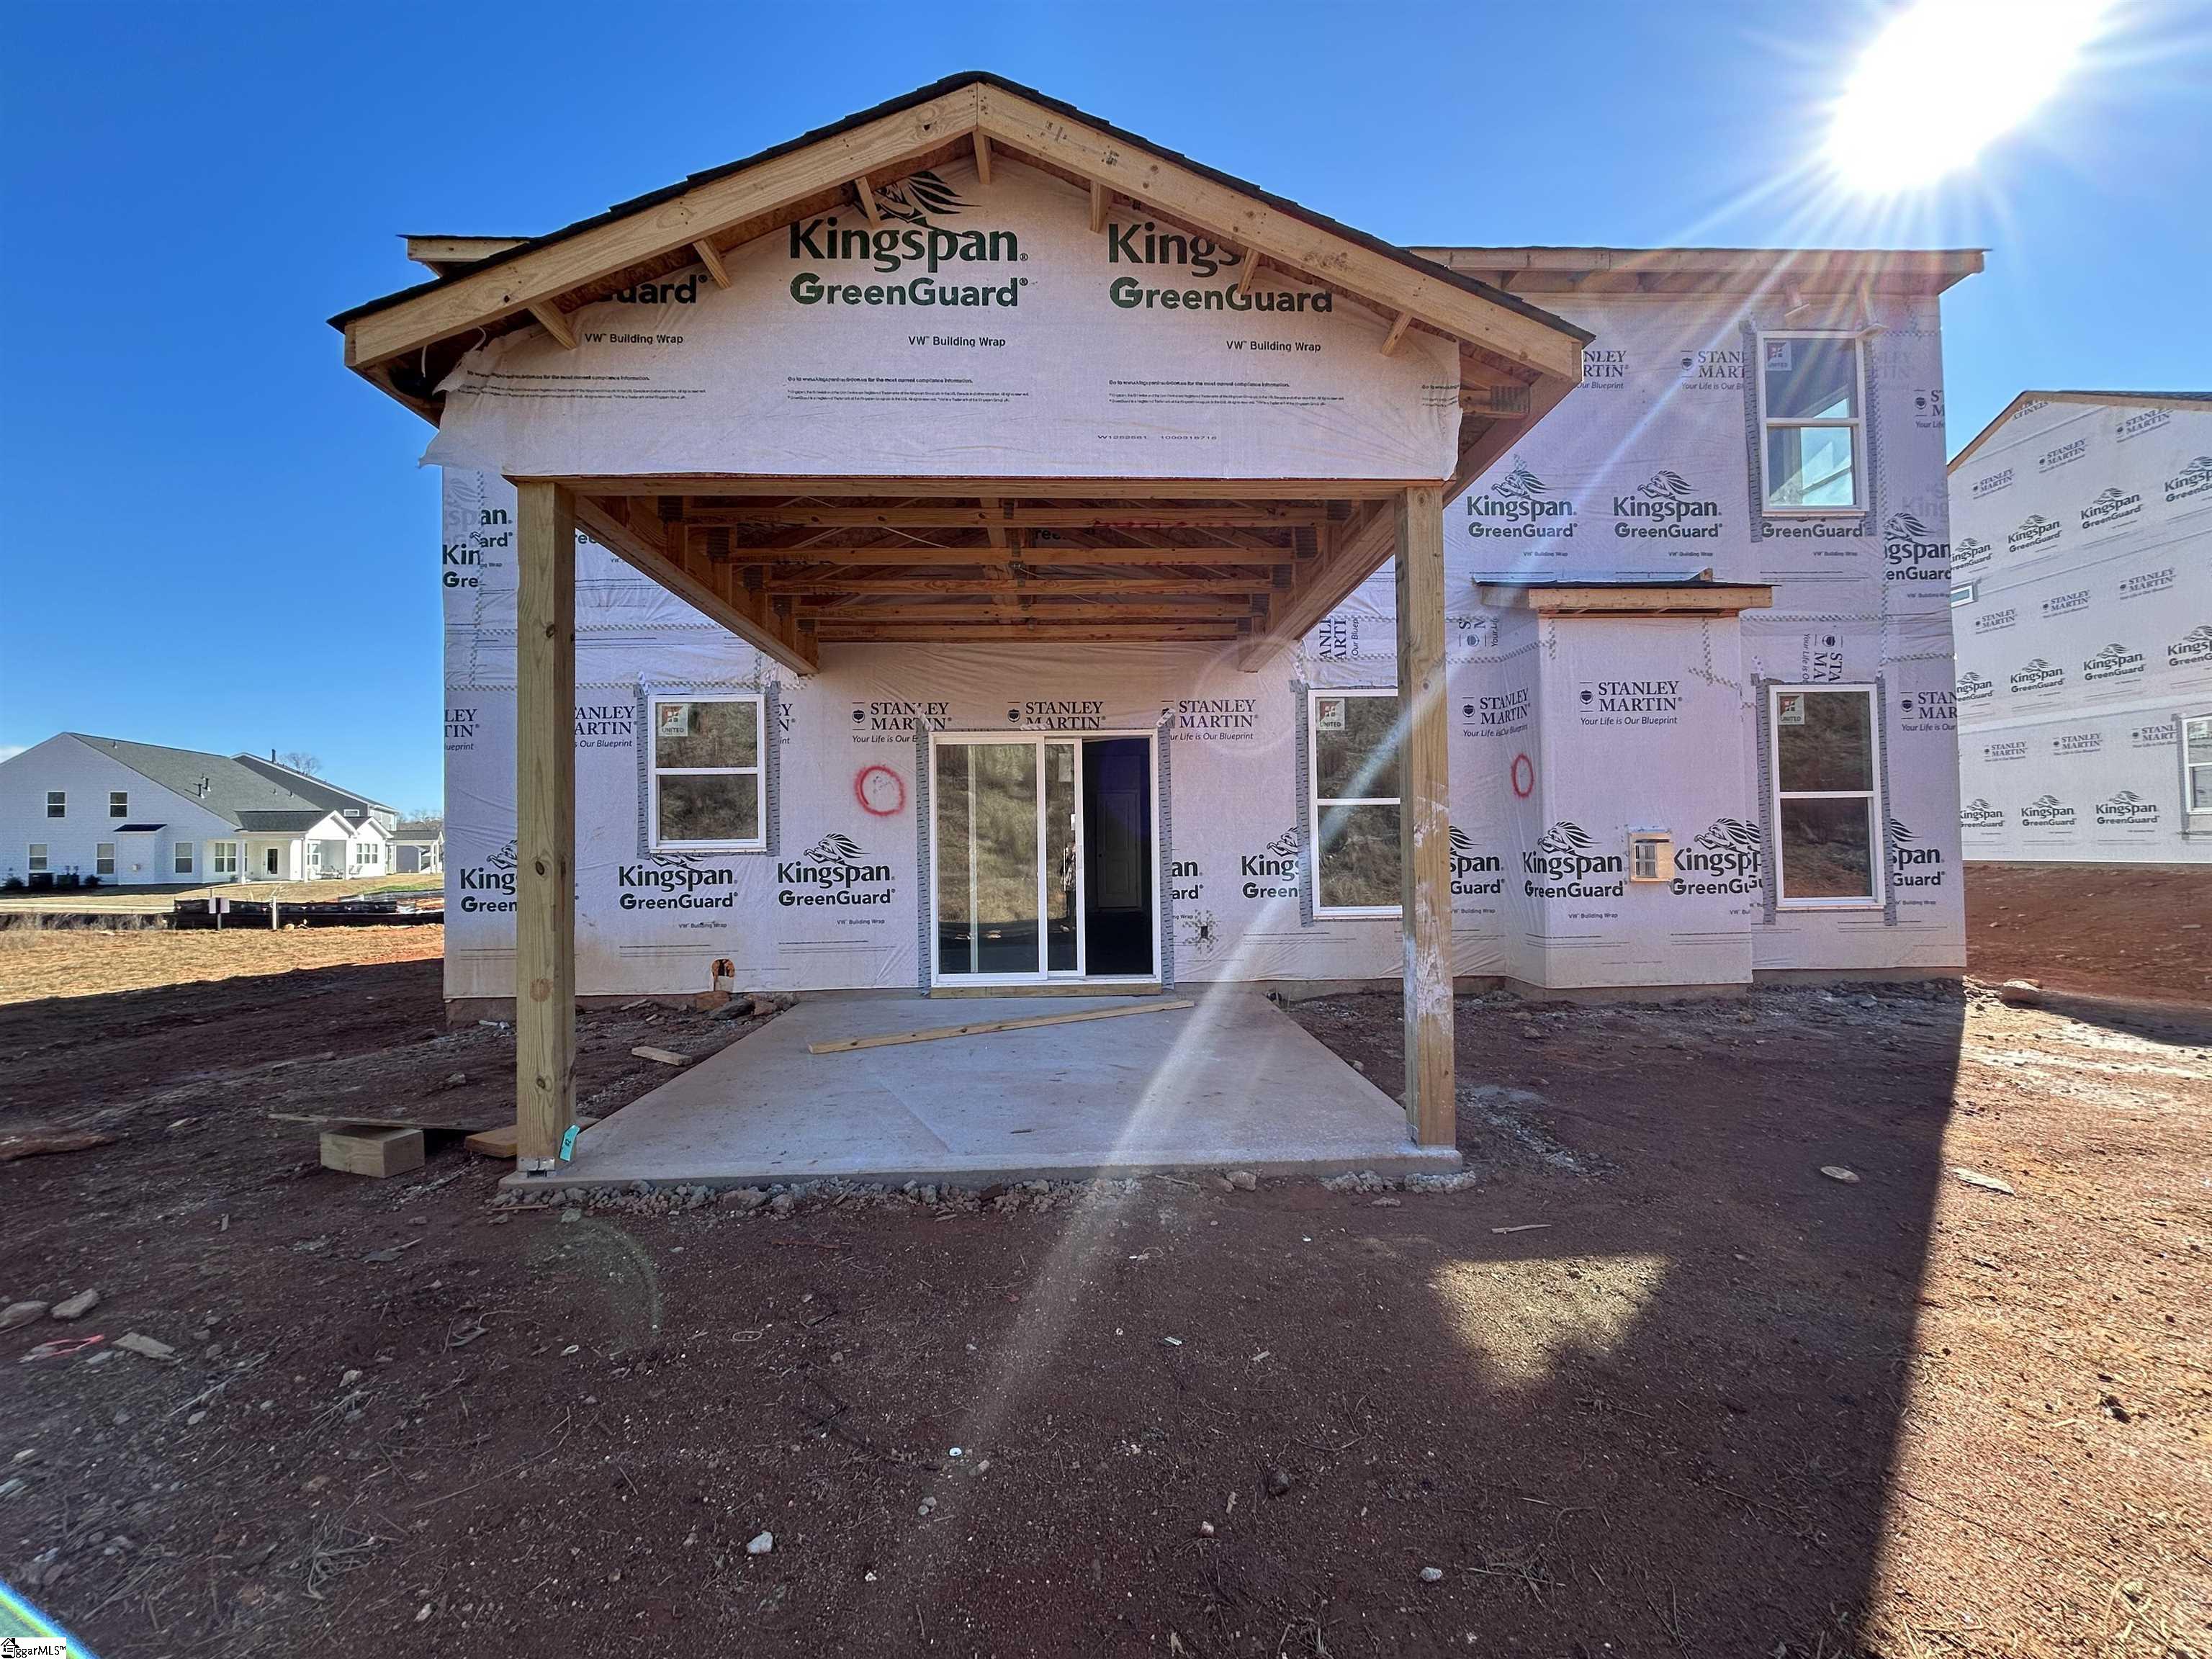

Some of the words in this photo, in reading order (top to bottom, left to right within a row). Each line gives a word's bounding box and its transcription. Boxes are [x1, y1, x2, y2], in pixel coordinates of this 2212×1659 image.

[610, 333, 653, 345] Building
[657, 334, 683, 345] Wrap
[933, 336, 975, 347] Building
[979, 337, 1006, 347] Wrap
[1251, 341, 1292, 352] Building
[1295, 342, 1321, 352] Wrap
[1591, 381, 1624, 390] Blueprint
[1681, 382, 1697, 390] Your
[1699, 382, 1712, 390] Life
[1721, 382, 1735, 390] Our
[1467, 495, 1573, 522] Kingspan
[1613, 495, 1718, 523] Kingspan
[2081, 494, 2141, 521] Kingspan
[2082, 505, 2142, 529] GreenGuard
[2008, 521, 2061, 544] Kingspan
[2083, 653, 2143, 671] Kingspan
[2010, 667, 2063, 683] Kingspan
[1599, 680, 1679, 696] STANLEY
[1957, 680, 1992, 695] ngspan
[1179, 699, 1256, 714] STANLEY
[1480, 688, 1529, 710] STANLEY
[1599, 697, 1677, 712] MARTIN
[1025, 701, 1104, 714] STANLEY
[1480, 704, 1528, 725] MARTIN
[1179, 715, 1254, 727] MARTIN
[1581, 717, 1596, 726] Your
[1599, 717, 1614, 726] Life
[1624, 717, 1639, 726] Our
[1641, 716, 1678, 726] Blueprint
[1902, 723, 1917, 732] Your
[1920, 723, 1933, 732] Life
[852, 734, 869, 743] Your
[871, 734, 885, 744] Life
[895, 734, 910, 743] Our
[1179, 733, 1193, 742] Life
[1219, 732, 1254, 741] Blueprint
[1463, 729, 1479, 737] Your
[1480, 729, 1494, 737] Life
[596, 739, 632, 748] Blueprint
[2021, 806, 2074, 819] Kingspan
[2095, 804, 2157, 816] Kingspan
[1523, 852, 1622, 881] Kingspan
[619, 865, 733, 891] Kingspan
[778, 861, 890, 889] Kingspan
[1524, 880, 1624, 898] GreenGuard
[619, 893, 734, 911] GreenGuard
[778, 889, 891, 906] GreenGuard
